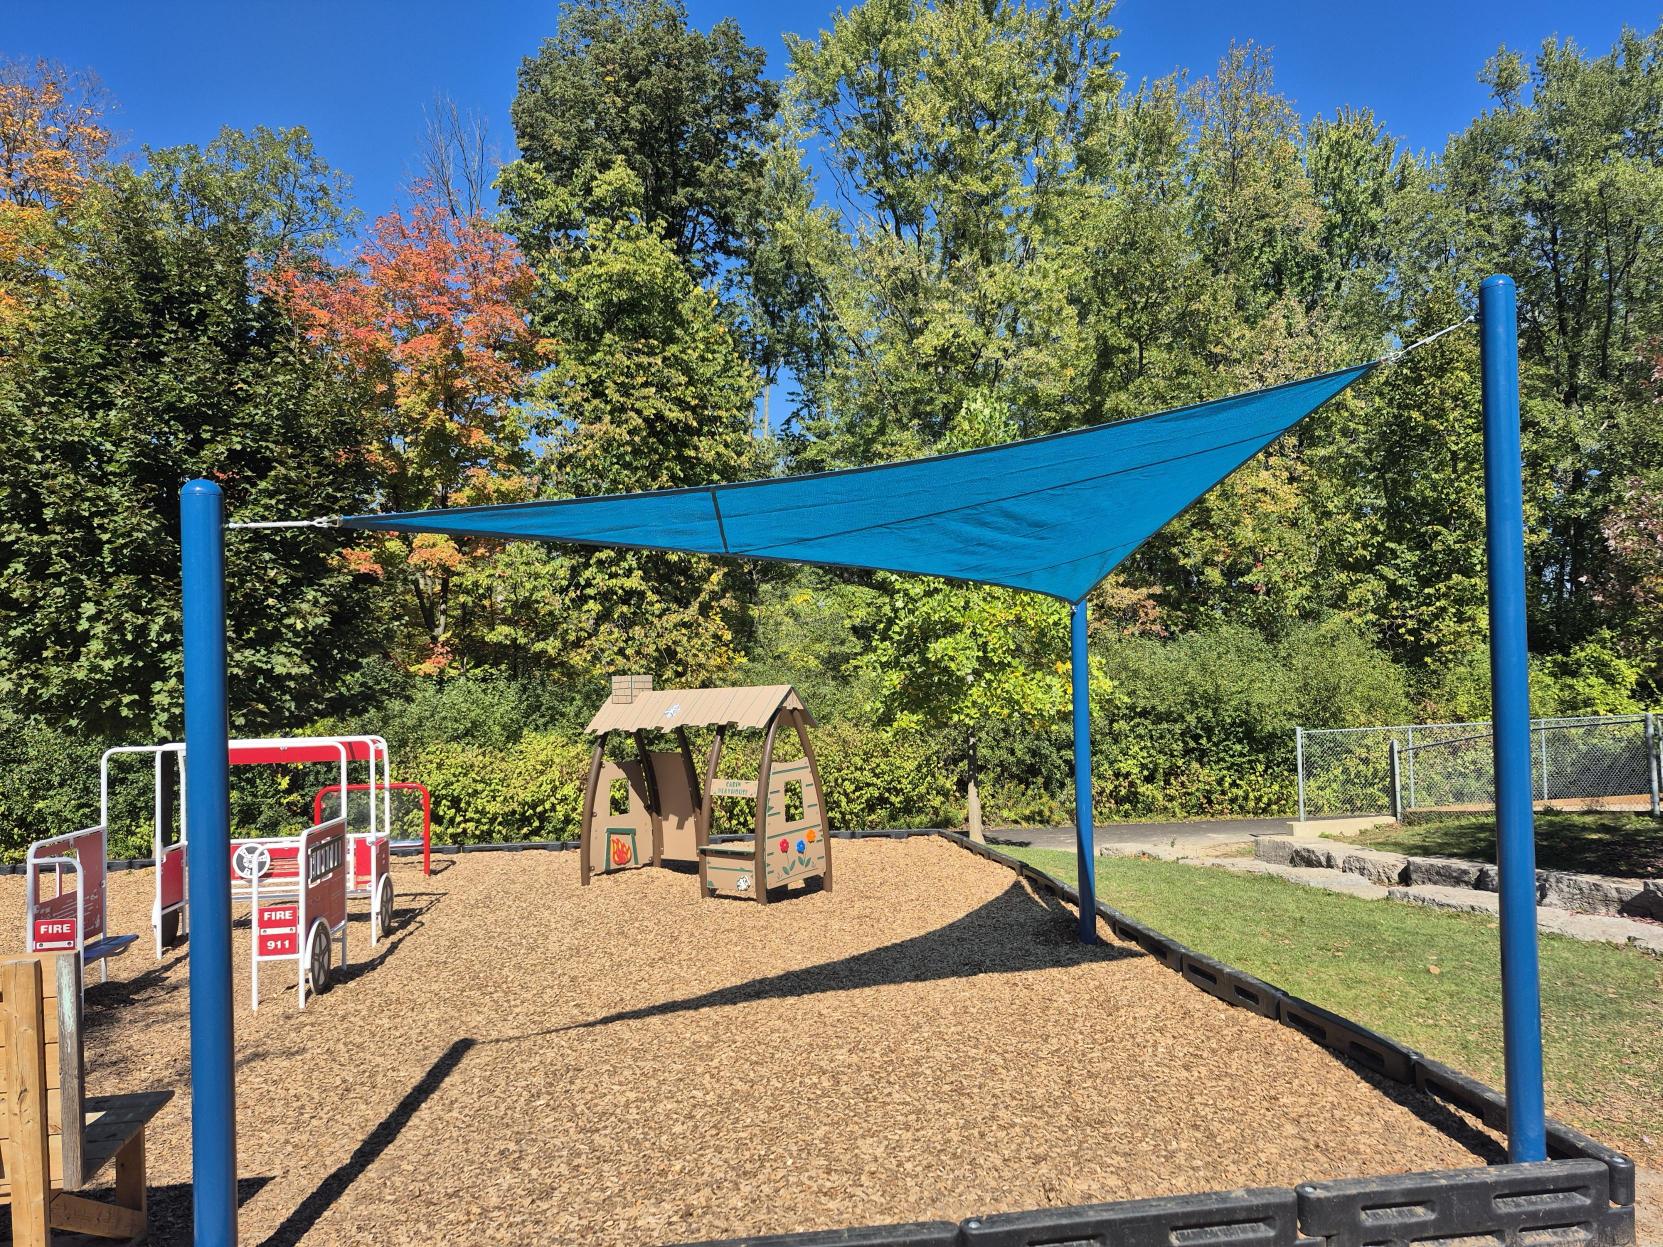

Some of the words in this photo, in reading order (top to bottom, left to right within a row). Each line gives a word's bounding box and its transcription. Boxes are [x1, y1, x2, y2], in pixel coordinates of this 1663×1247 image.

[263, 910, 294, 921] FIRE
[40, 923, 71, 935] FIRE
[266, 940, 290, 950] 911
